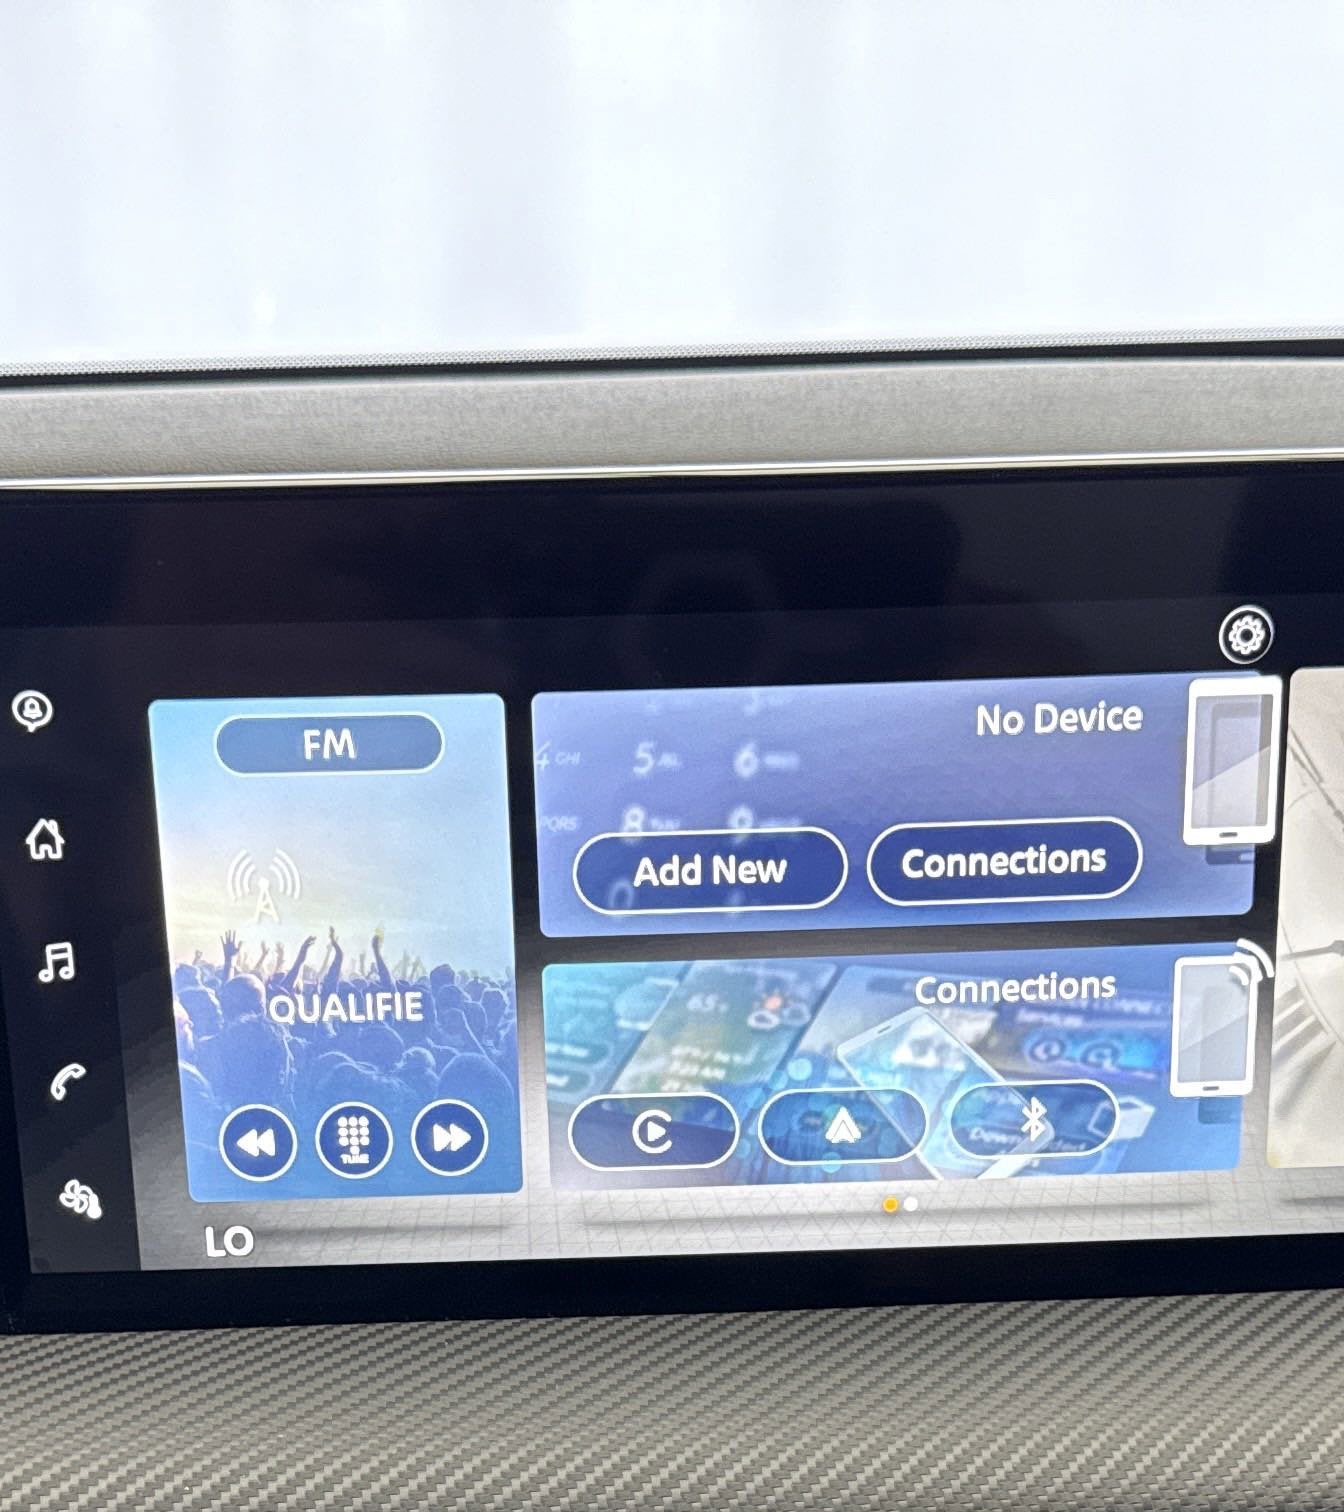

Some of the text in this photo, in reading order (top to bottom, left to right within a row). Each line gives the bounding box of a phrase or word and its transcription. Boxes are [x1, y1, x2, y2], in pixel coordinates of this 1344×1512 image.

[976, 700, 1144, 736] No Device
[303, 728, 356, 760] FM
[633, 853, 788, 888] Add New
[901, 848, 1108, 881] Connections
[914, 972, 1118, 1004] Connections
[268, 991, 423, 1024] QUALIFIE
[205, 1225, 255, 1258] LO
